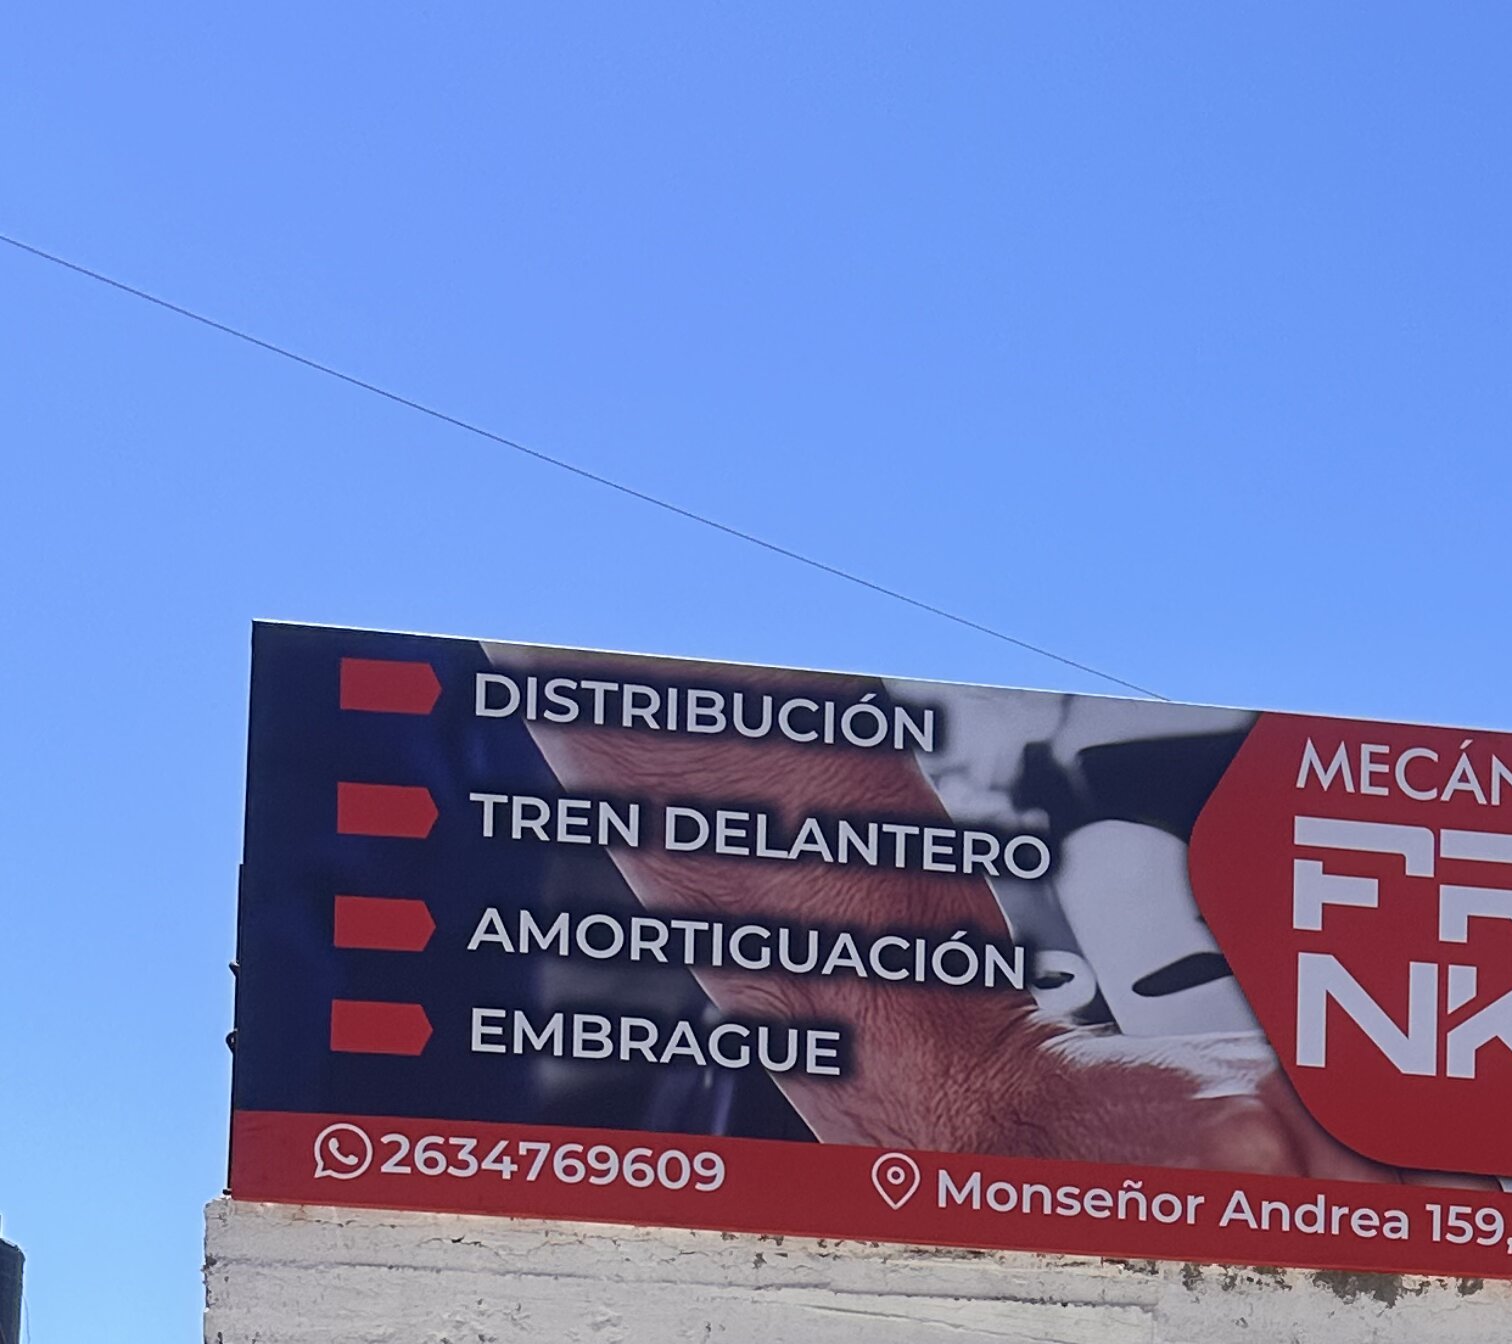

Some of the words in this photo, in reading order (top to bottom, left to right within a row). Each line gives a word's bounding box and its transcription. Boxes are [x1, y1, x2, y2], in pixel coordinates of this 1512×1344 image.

[474, 672, 936, 753] DISTRIBUCIÓN
[469, 793, 641, 848] TREN
[664, 804, 1052, 881] DELANTERO
[467, 905, 1026, 990] AMORTIGUACIÓN
[470, 1008, 842, 1077] EMBRAGUE
[381, 1133, 726, 1191] 2634769609
[936, 1168, 1205, 1228] Monseñor
[1219, 1193, 1409, 1241] Andrea
